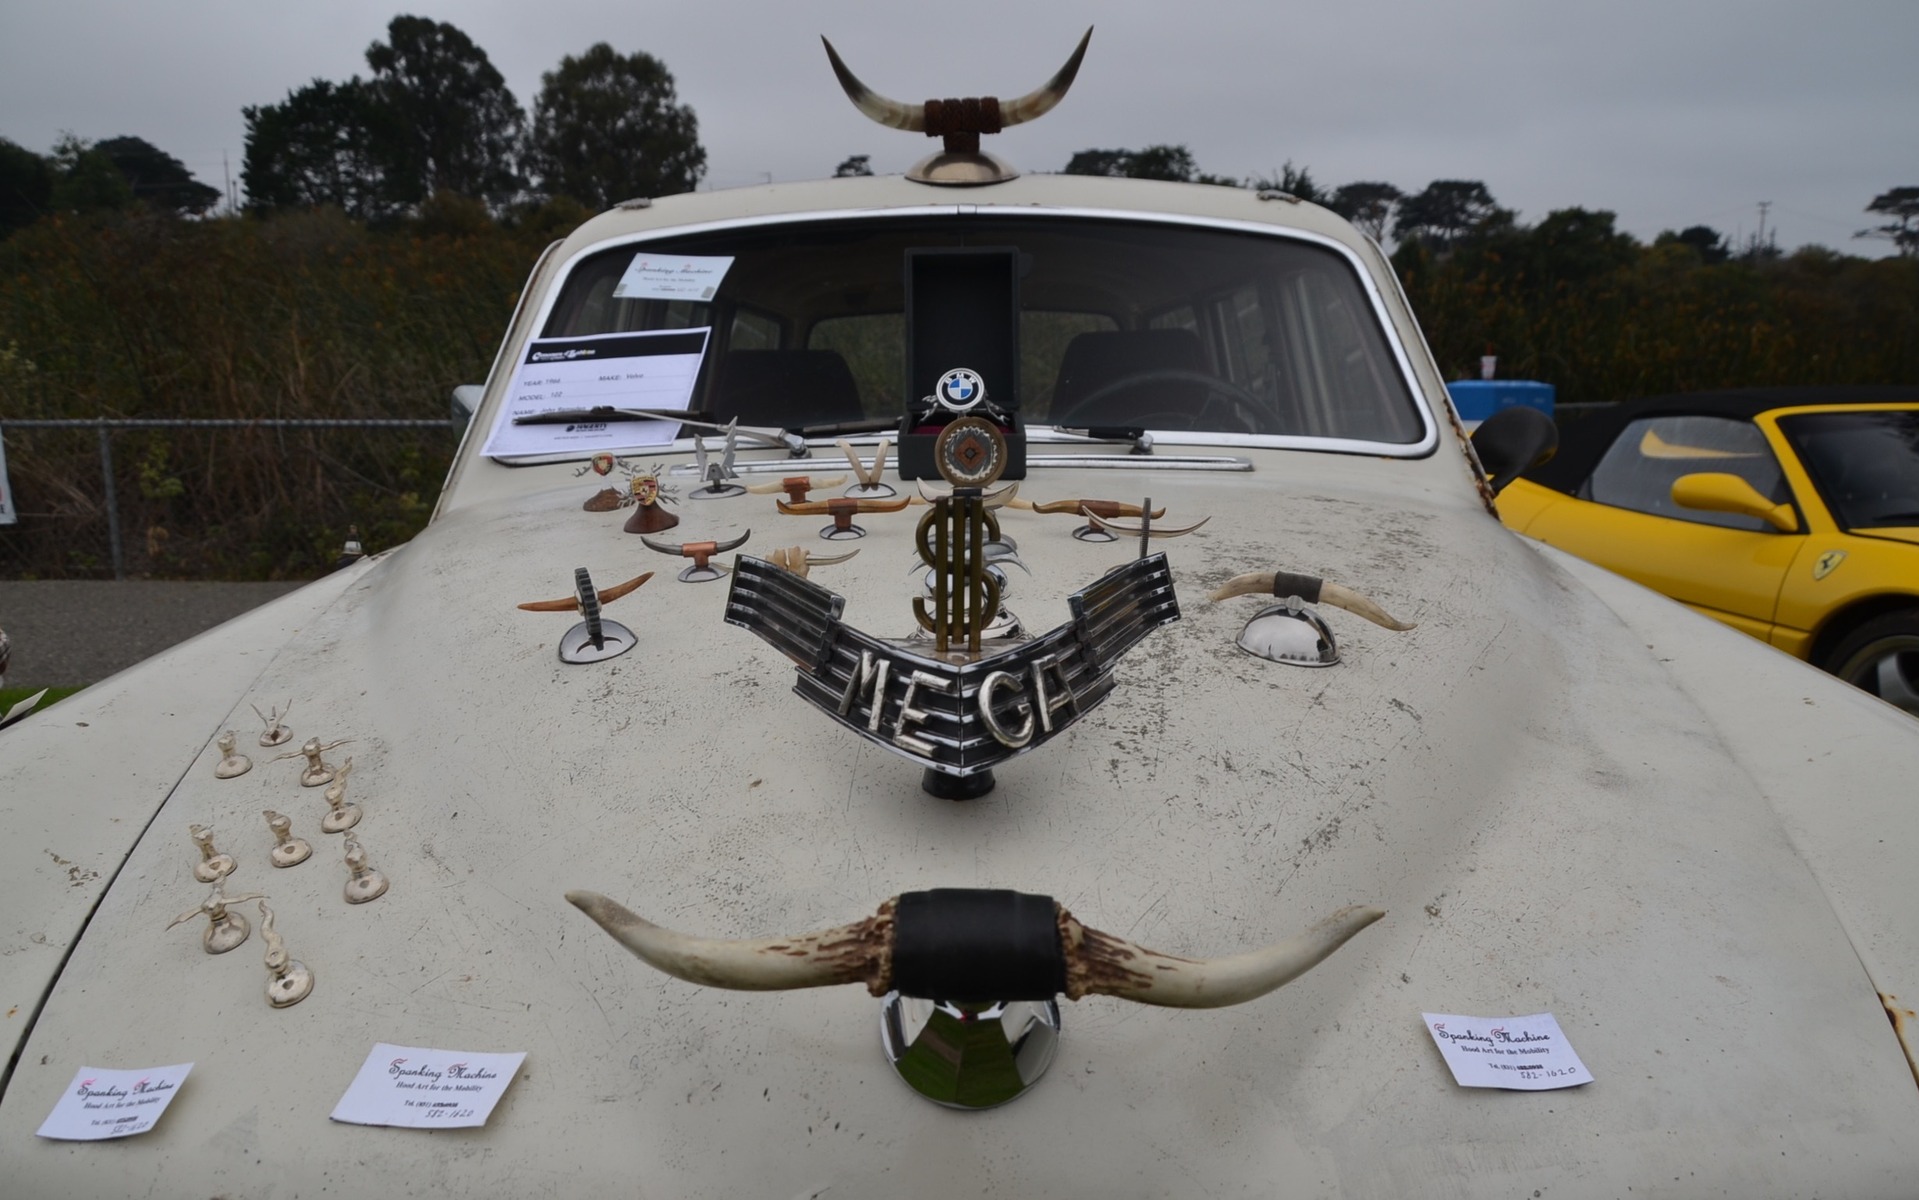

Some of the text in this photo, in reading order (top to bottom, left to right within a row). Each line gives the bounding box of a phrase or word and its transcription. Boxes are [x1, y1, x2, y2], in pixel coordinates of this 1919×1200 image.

[945, 372, 977, 385] BMW
[1434, 1023, 1550, 1047] Spanking Machine
[1481, 1046, 1493, 1054] Art
[1506, 1047, 1517, 1055] the
[1518, 1047, 1550, 1056] Mobility
[389, 1058, 497, 1082] Spanking Machine
[77, 1077, 174, 1101] Spanking Machine
[429, 1083, 440, 1091] for
[453, 1084, 483, 1093] Mobility
